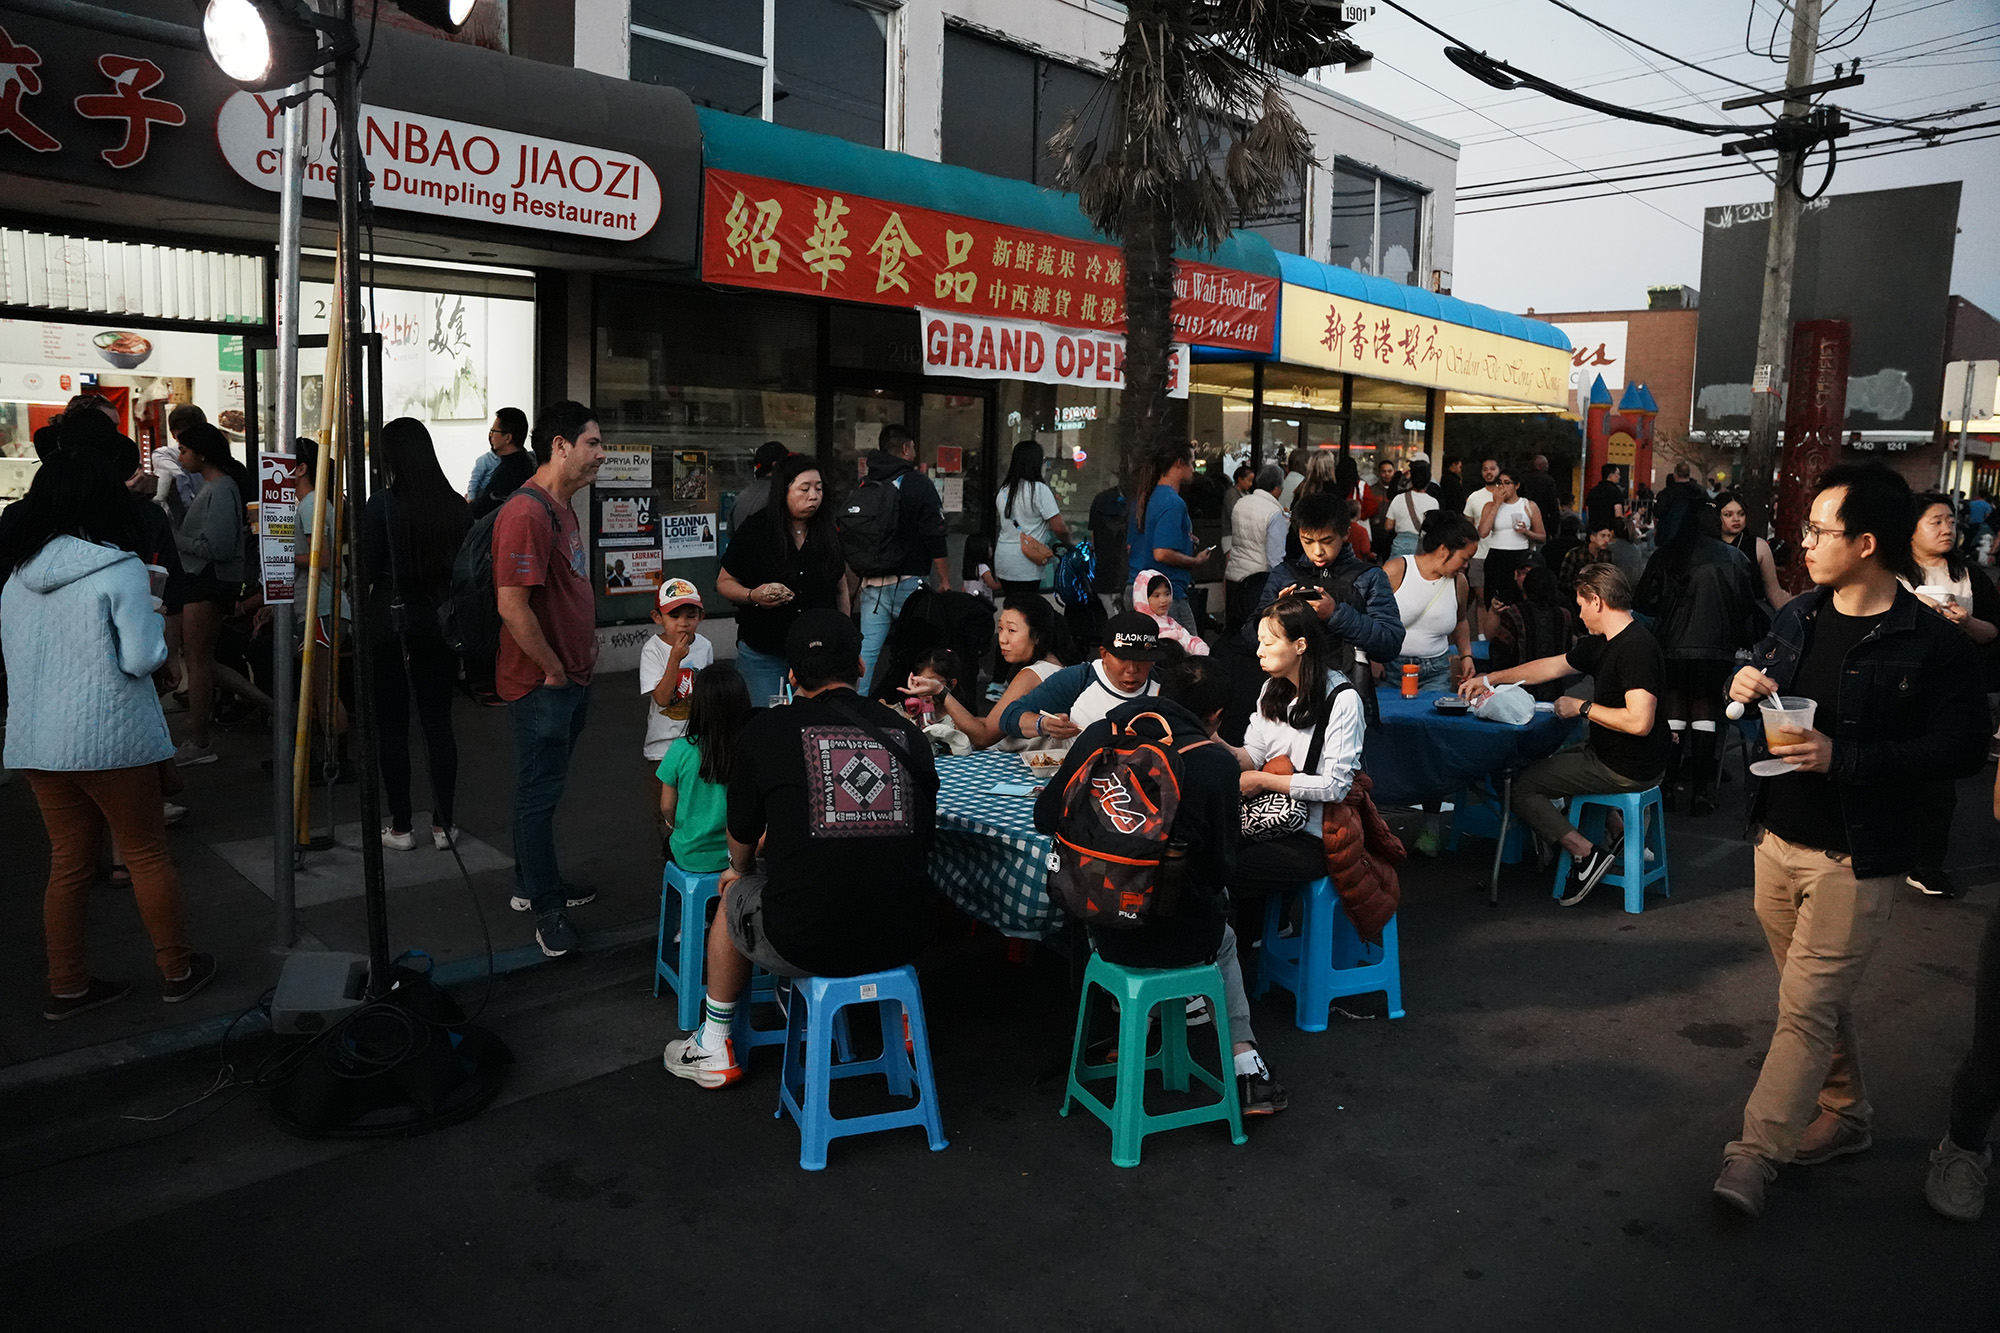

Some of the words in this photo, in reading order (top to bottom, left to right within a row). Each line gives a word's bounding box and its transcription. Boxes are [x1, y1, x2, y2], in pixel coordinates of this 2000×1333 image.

[1345, 6, 1367, 22] 1901
[252, 93, 500, 175] YNBAO
[511, 144, 640, 200] JIAOZI
[383, 168, 506, 215] Dumpling
[513, 191, 637, 231] Restaurant
[724, 189, 978, 304] 紹華食品
[991, 236, 1076, 279] 新鮮蔬果
[988, 278, 1072, 319] 中西雜貨
[1193, 272, 1217, 304] Wah
[1218, 277, 1248, 308] Food
[1247, 283, 1268, 312] Inc.
[1209, 318, 1259, 342] 702-6181
[926, 318, 1046, 374] GRAND
[1852, 442, 1875, 451] 1240
[1887, 442, 1907, 451] 1241
[633, 454, 650, 466] RAY
[265, 489, 279, 501] NO
[664, 516, 709, 528] LEANNA
[664, 526, 698, 538] LOUIE
[631, 551, 660, 560] LAURANCE
[1091, 772, 1147, 834] FILA
[1118, 910, 1138, 920] FILA
